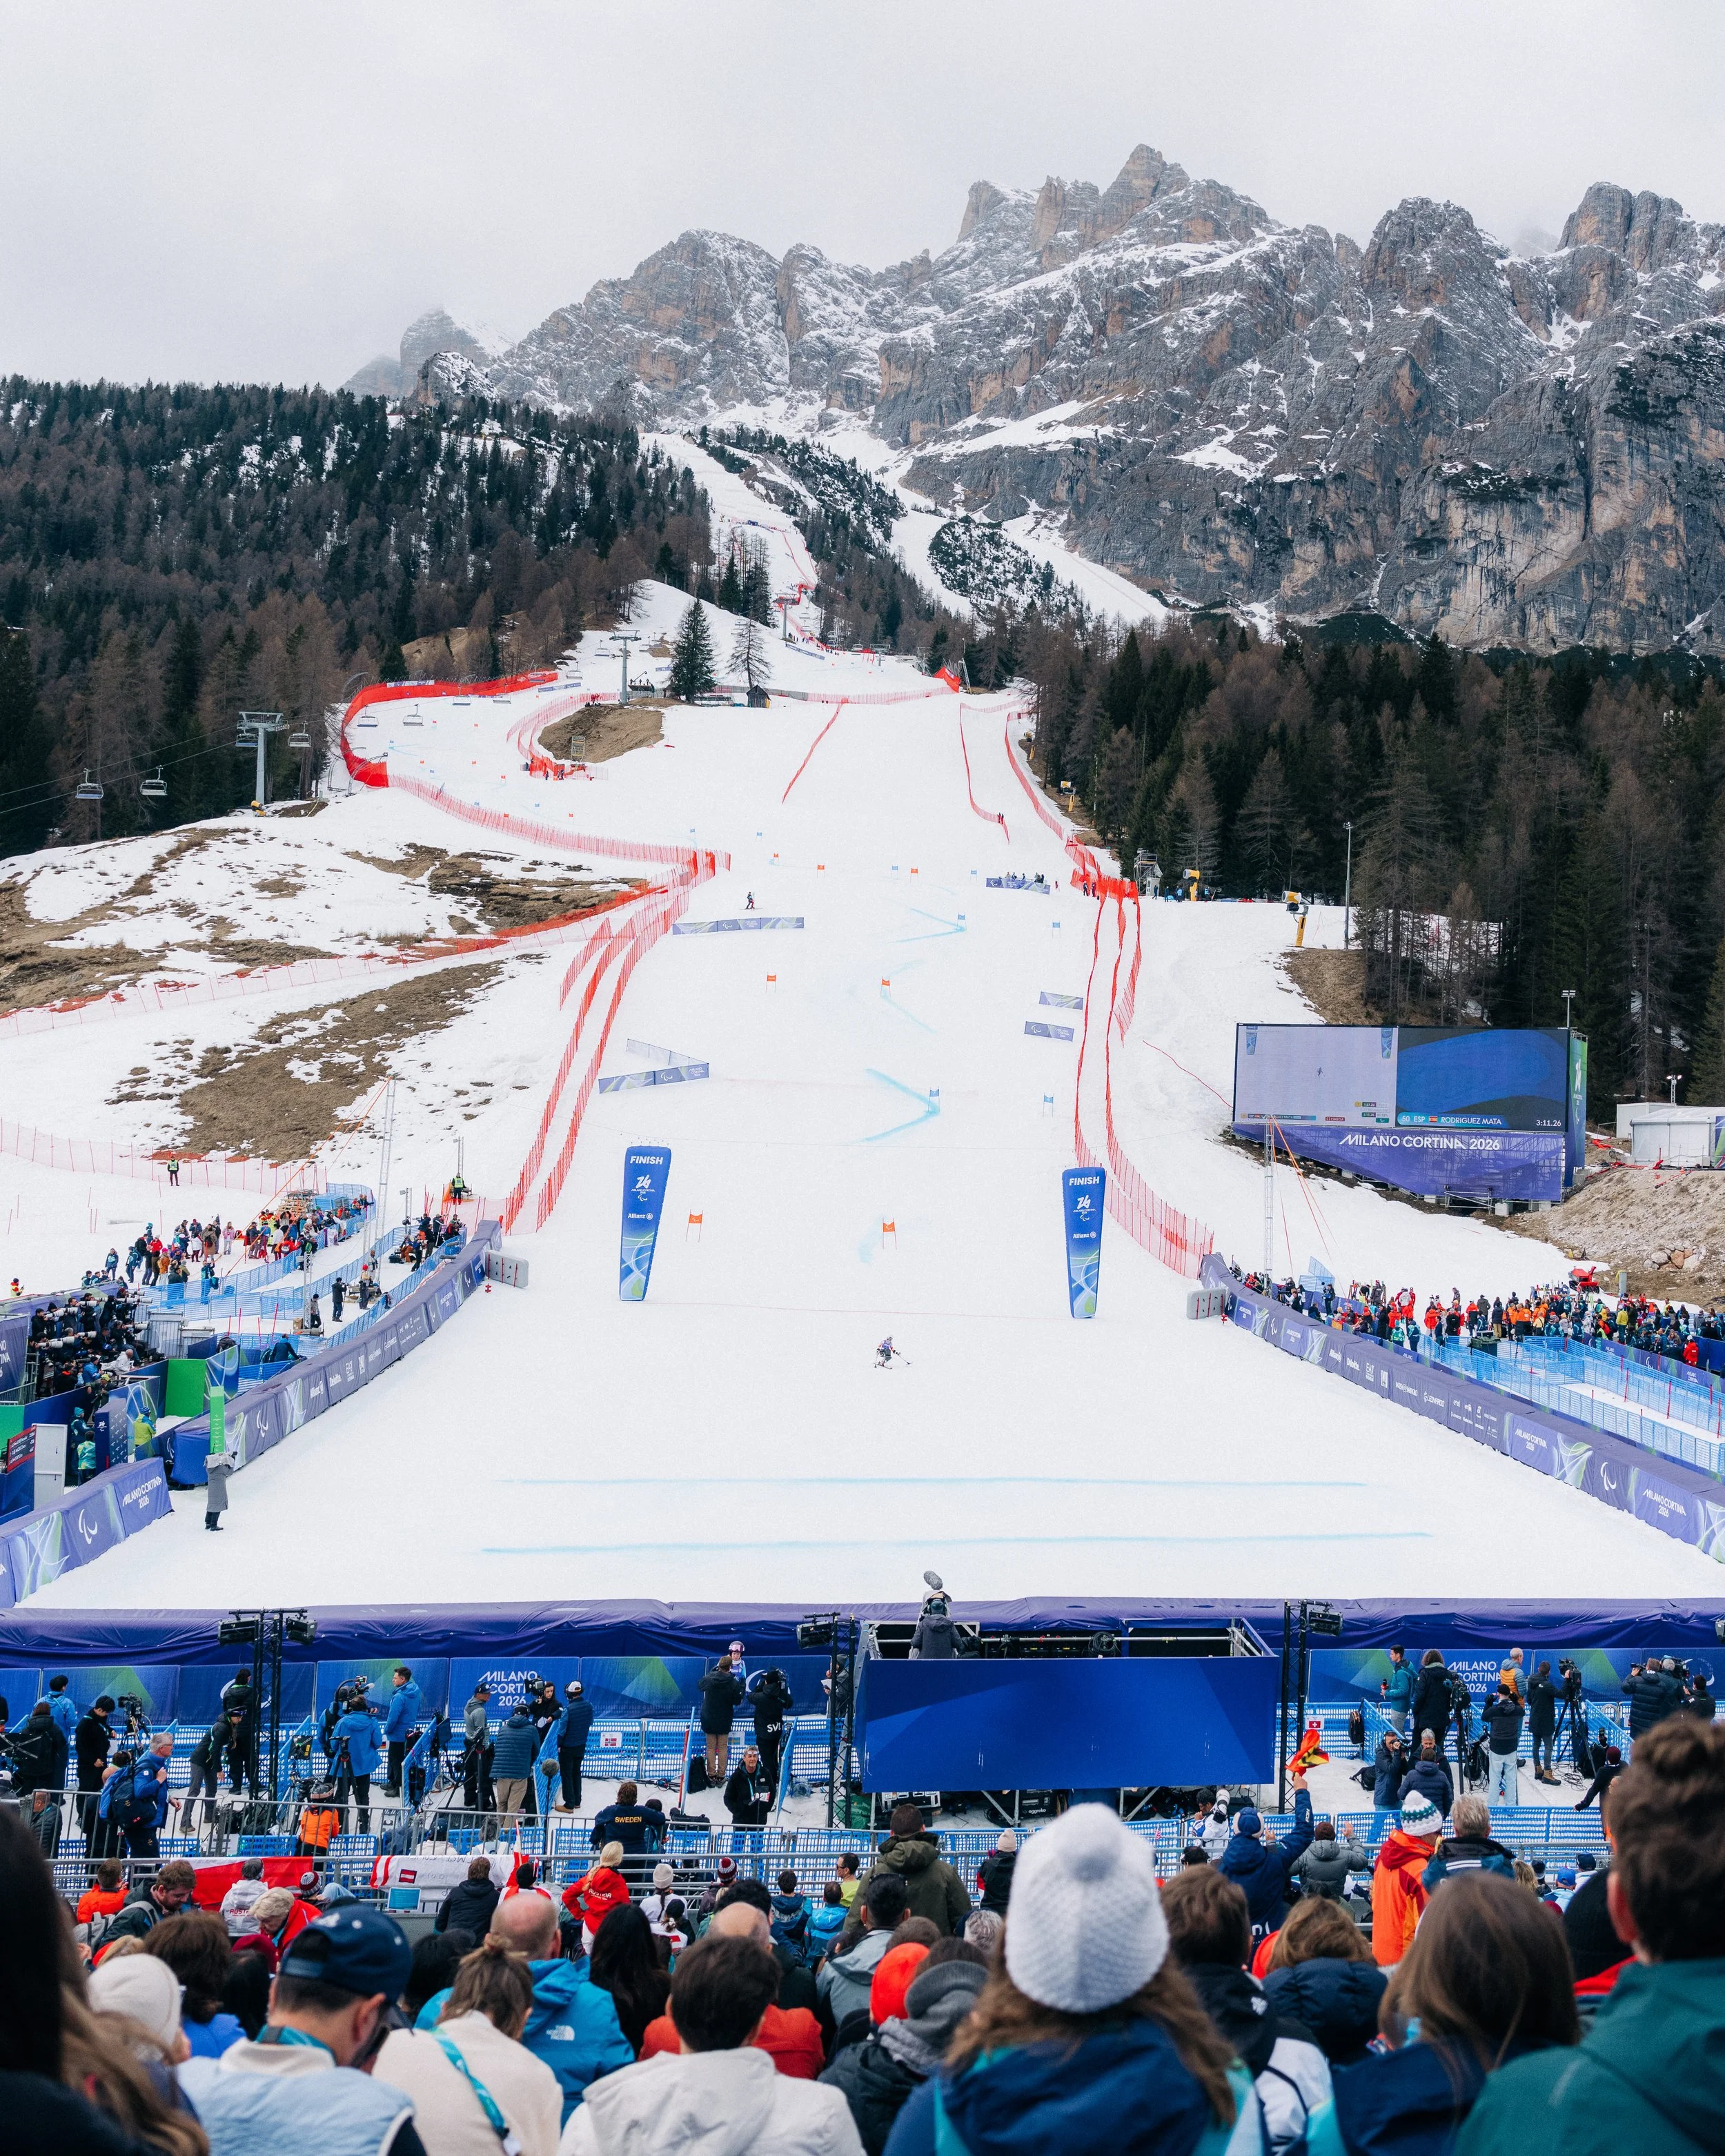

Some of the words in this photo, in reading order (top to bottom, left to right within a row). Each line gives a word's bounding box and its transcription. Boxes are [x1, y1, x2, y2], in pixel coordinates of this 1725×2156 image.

[1441, 1116, 1481, 1125] RODRIGUEZ
[1339, 1134, 1401, 1147] MILANO
[1403, 1136, 1467, 1149] CORTINA
[1470, 1138, 1500, 1151] 2026
[630, 1156, 664, 1165] FINISH
[1069, 1176, 1101, 1186] FINISH
[1515, 1428, 1531, 1441] MILANO
[1530, 1434, 1547, 1449] CORTINA
[1526, 1441, 1535, 1452] 2026
[122, 1487, 142, 1507] MILANO
[141, 1476, 163, 1494] CORTINA
[139, 1495, 150, 1509] 2026
[1643, 1488, 1664, 1505] MILANO
[1664, 1497, 1687, 1516] CORTINA
[1658, 1505, 1669, 1518] 2026
[1447, 1661, 1497, 1671] MILANO
[477, 1670, 538, 1682] MILANO
[489, 1683, 526, 1694] CORTI
[497, 1695, 526, 1706] 2026
